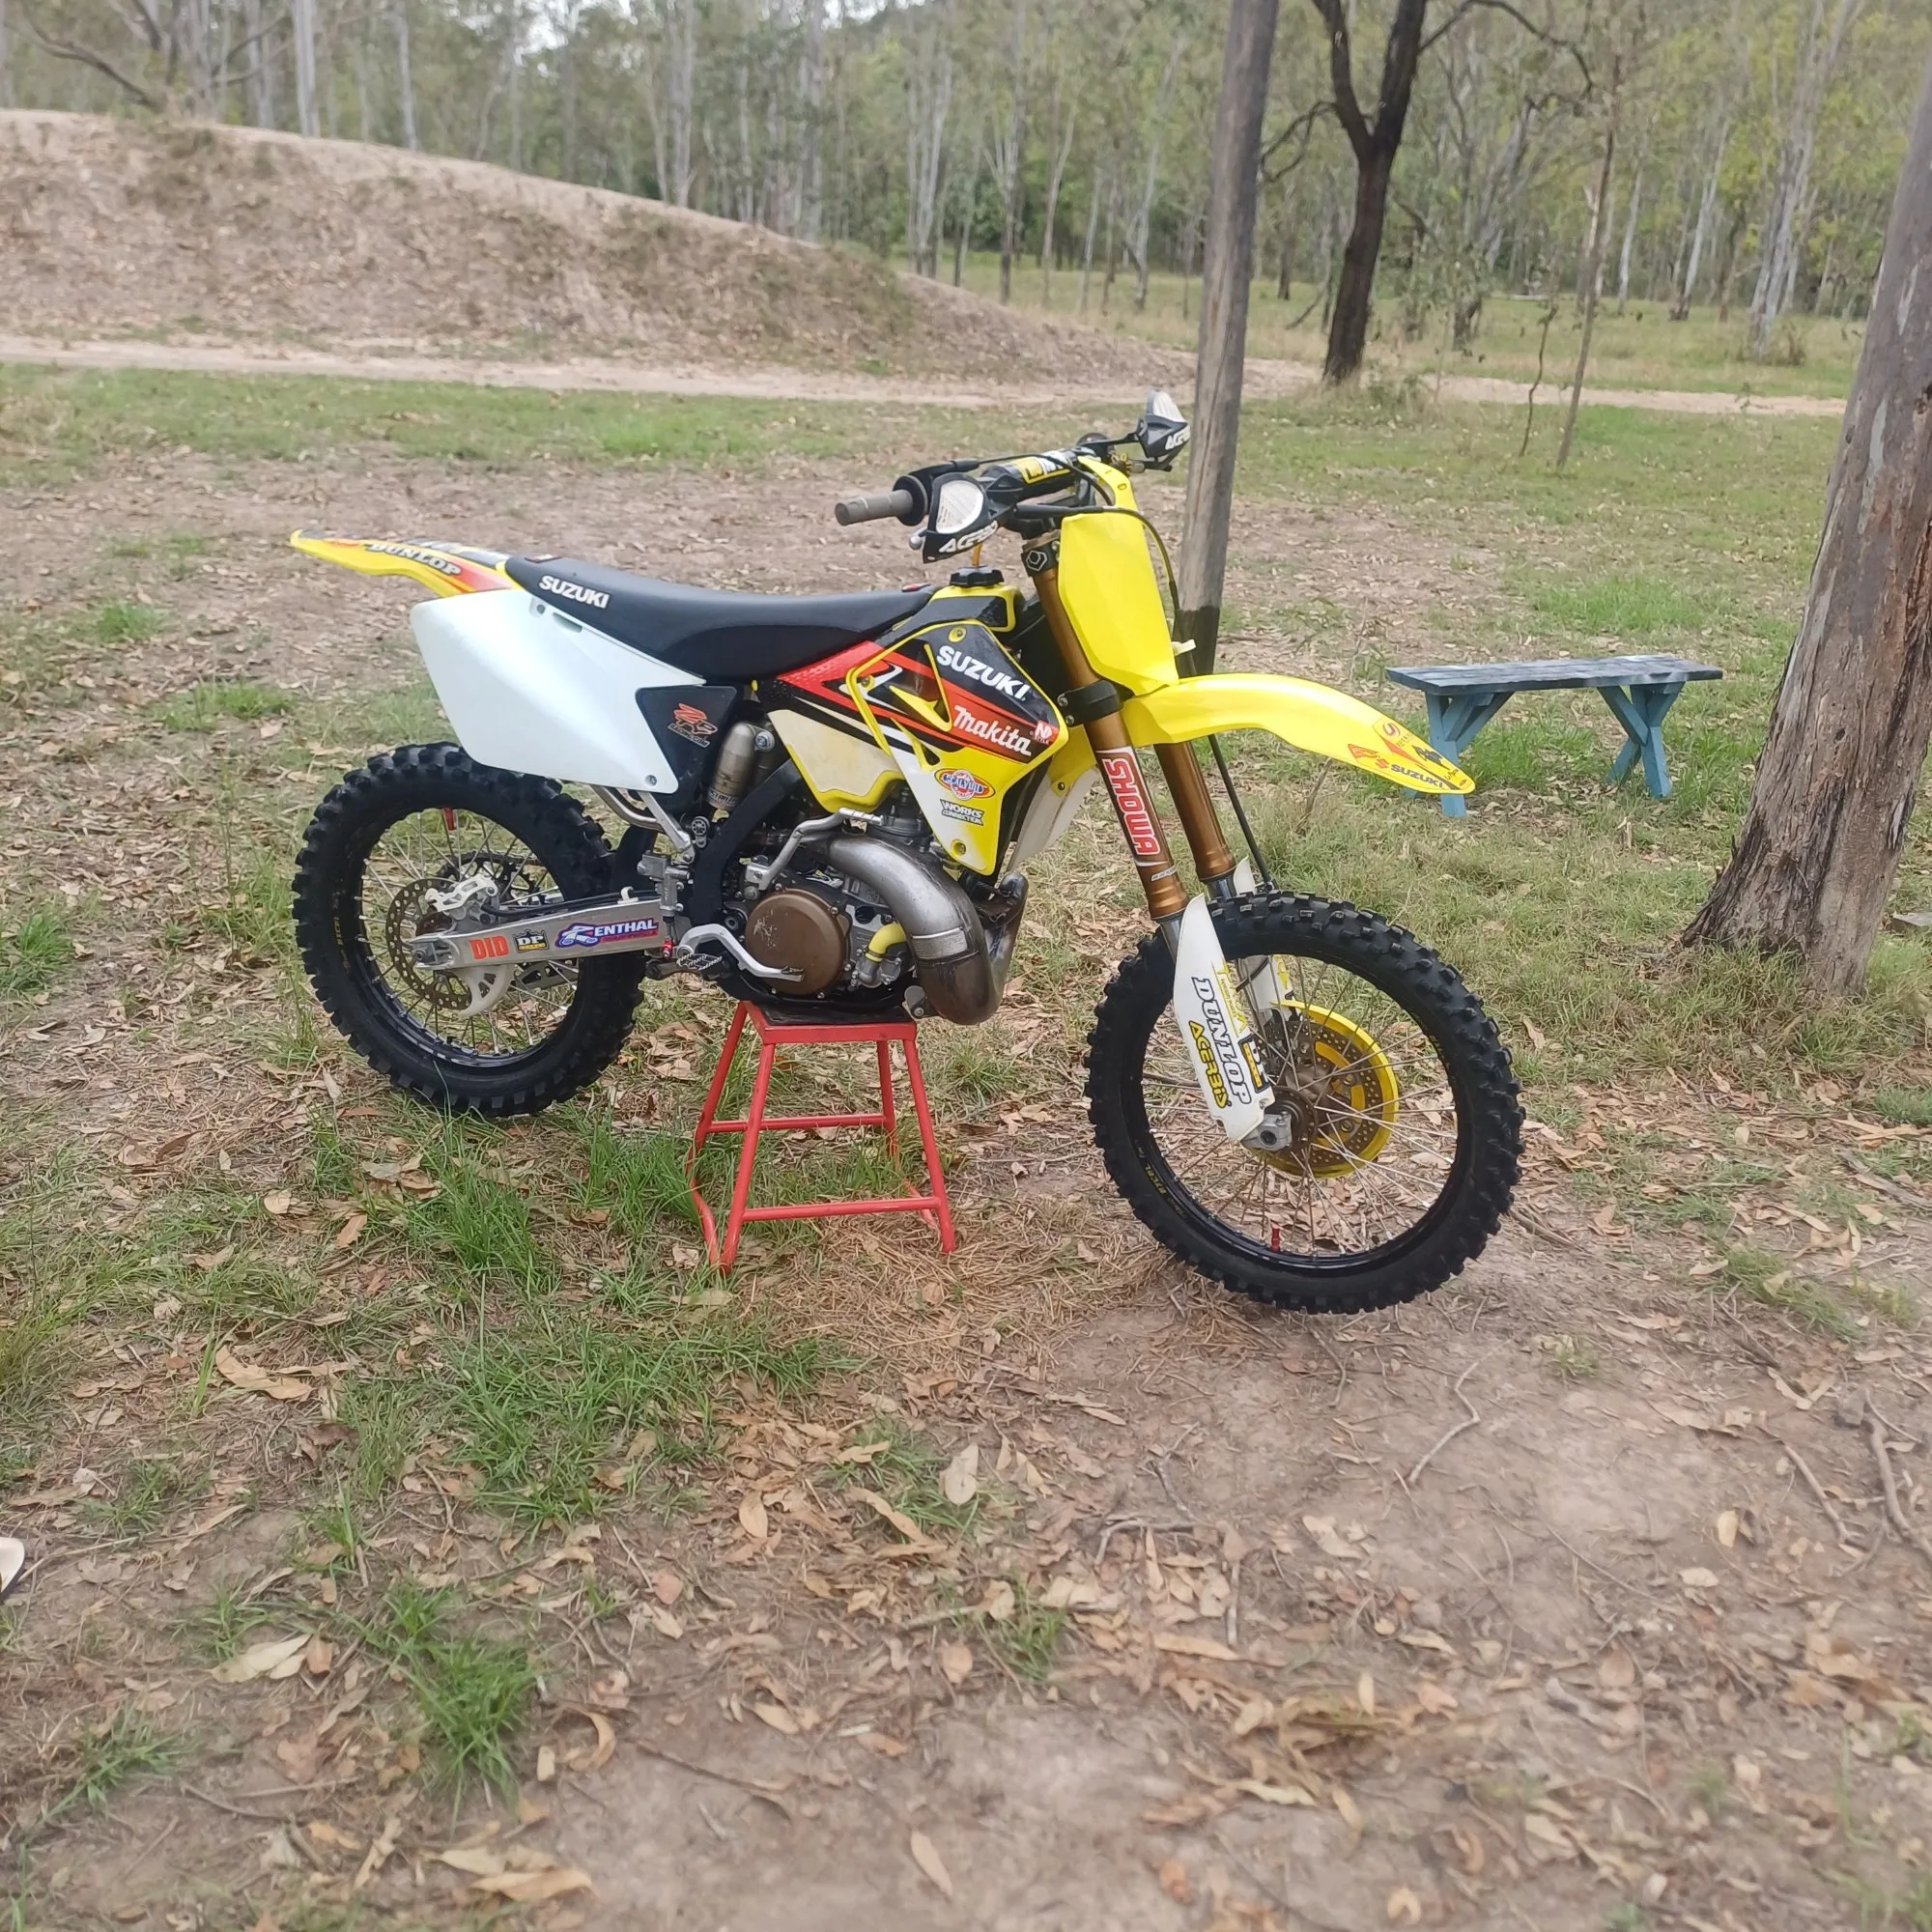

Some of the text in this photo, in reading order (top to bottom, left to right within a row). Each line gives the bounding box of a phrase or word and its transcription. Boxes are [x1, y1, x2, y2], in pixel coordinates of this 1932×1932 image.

[364, 543, 462, 576] DUNLOP
[538, 574, 611, 609] SUZUKI
[936, 645, 1032, 702] SUZUKI
[953, 704, 1033, 756] makita
[1390, 763, 1444, 788] SUZUKI
[941, 799, 983, 819] WORKS
[1101, 757, 1161, 856] SHOWA
[469, 935, 509, 959] DID
[517, 934, 545, 946] DP
[1191, 977, 1252, 1105] DUNLOP
